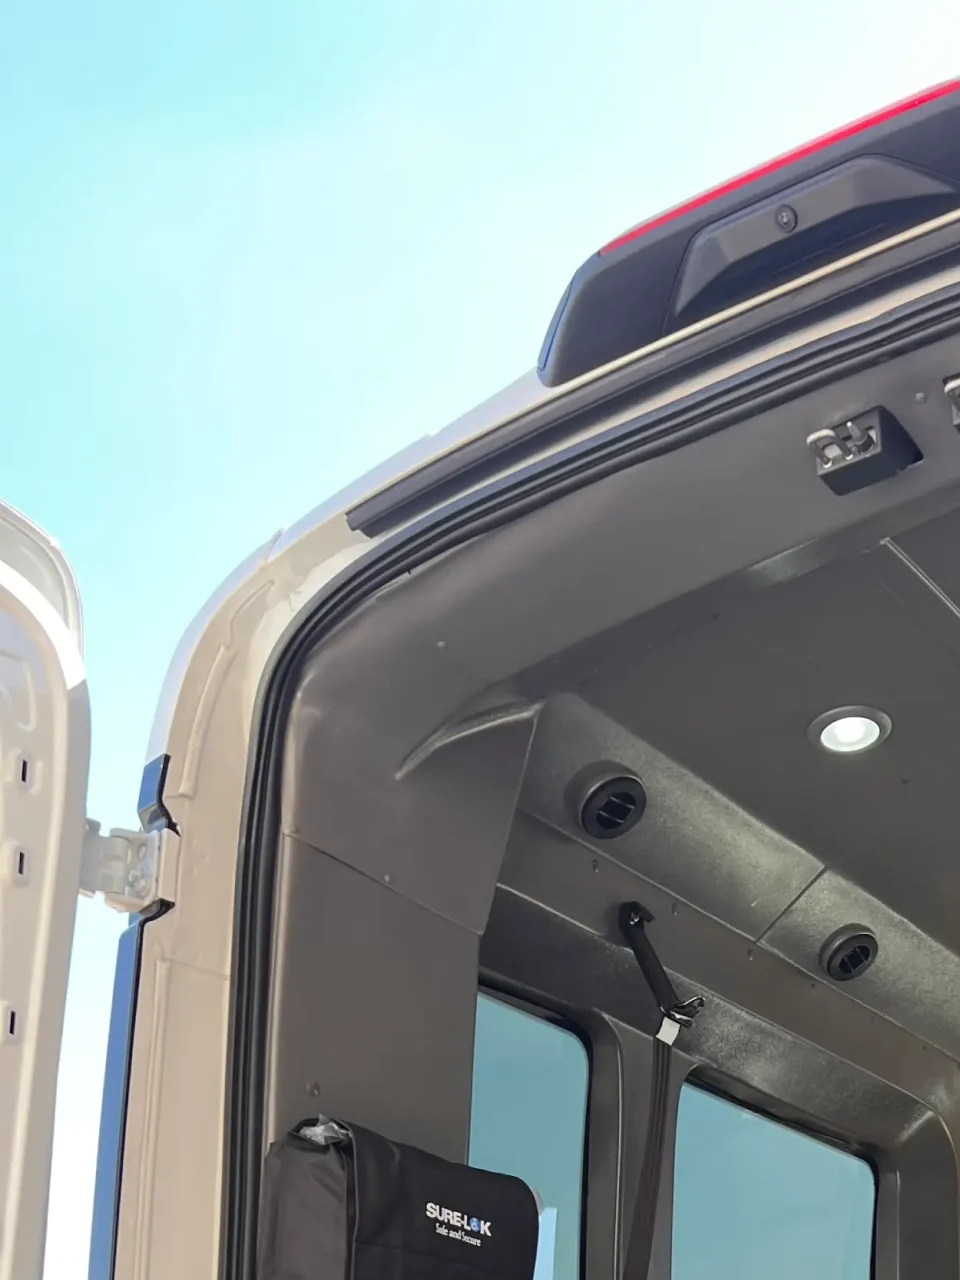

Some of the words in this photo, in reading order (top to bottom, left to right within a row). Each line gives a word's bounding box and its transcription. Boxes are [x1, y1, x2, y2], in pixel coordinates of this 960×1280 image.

[435, 1222, 448, 1236] Safe
[449, 1230, 462, 1240] and
[462, 1231, 482, 1247] Secure
